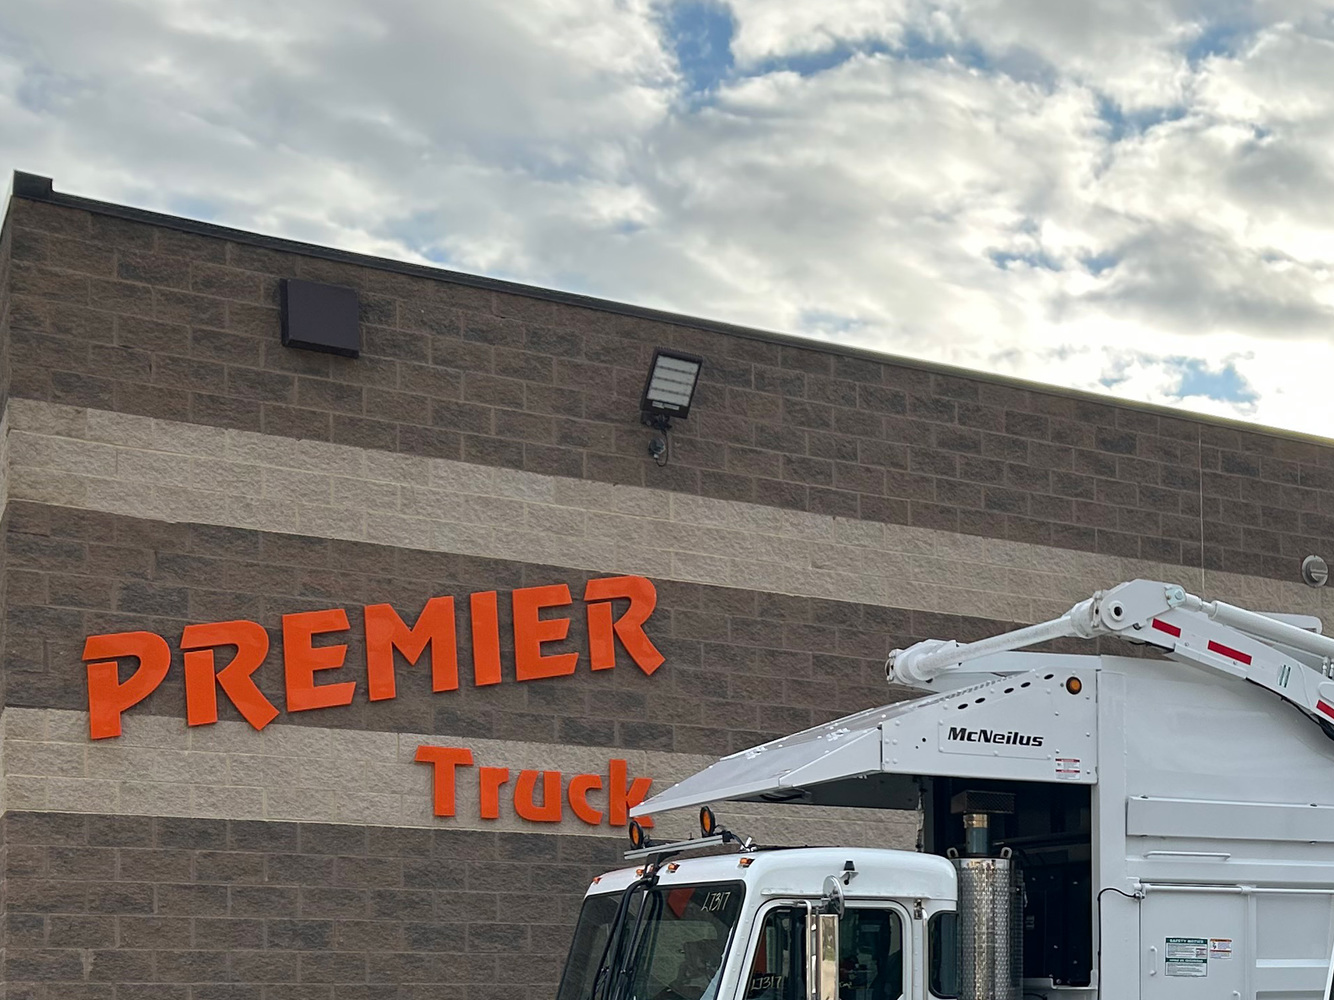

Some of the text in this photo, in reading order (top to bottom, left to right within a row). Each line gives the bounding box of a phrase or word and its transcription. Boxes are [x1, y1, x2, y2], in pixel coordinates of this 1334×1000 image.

[83, 575, 665, 740] PREMIER
[947, 727, 1044, 747] McNeilus
[415, 746, 654, 827] Truck
